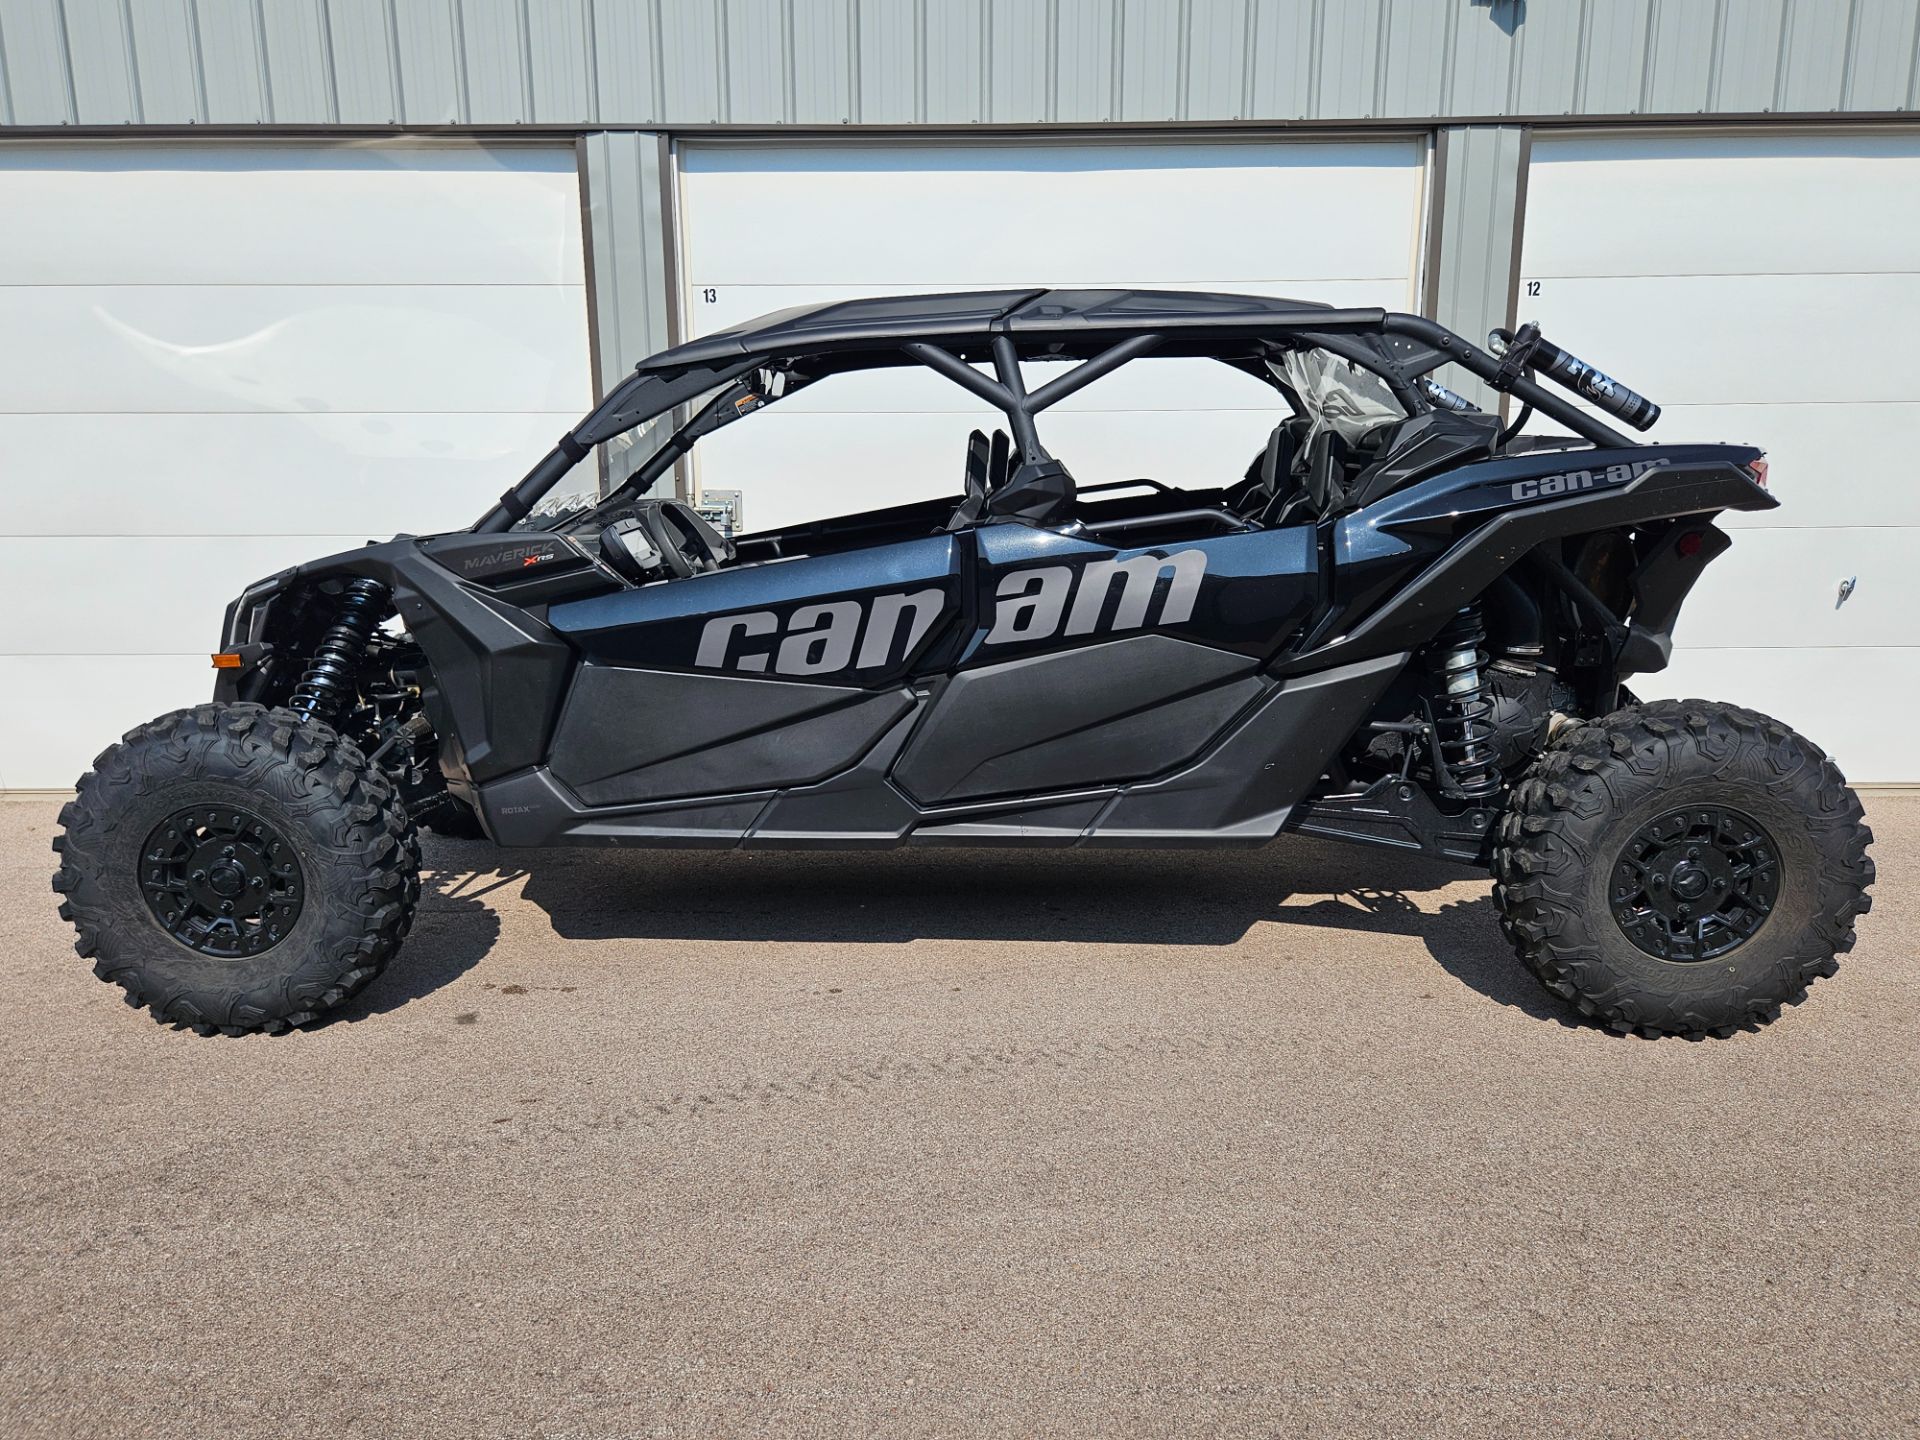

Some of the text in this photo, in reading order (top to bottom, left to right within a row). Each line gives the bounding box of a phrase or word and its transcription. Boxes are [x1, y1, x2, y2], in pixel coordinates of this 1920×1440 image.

[703, 288, 717, 303] 13
[1527, 281, 1541, 296] 12
[1566, 357, 1616, 399] FOX
[463, 540, 556, 571] MAVERICK
[694, 549, 1208, 676] can am
[501, 805, 530, 815] ROTAX
